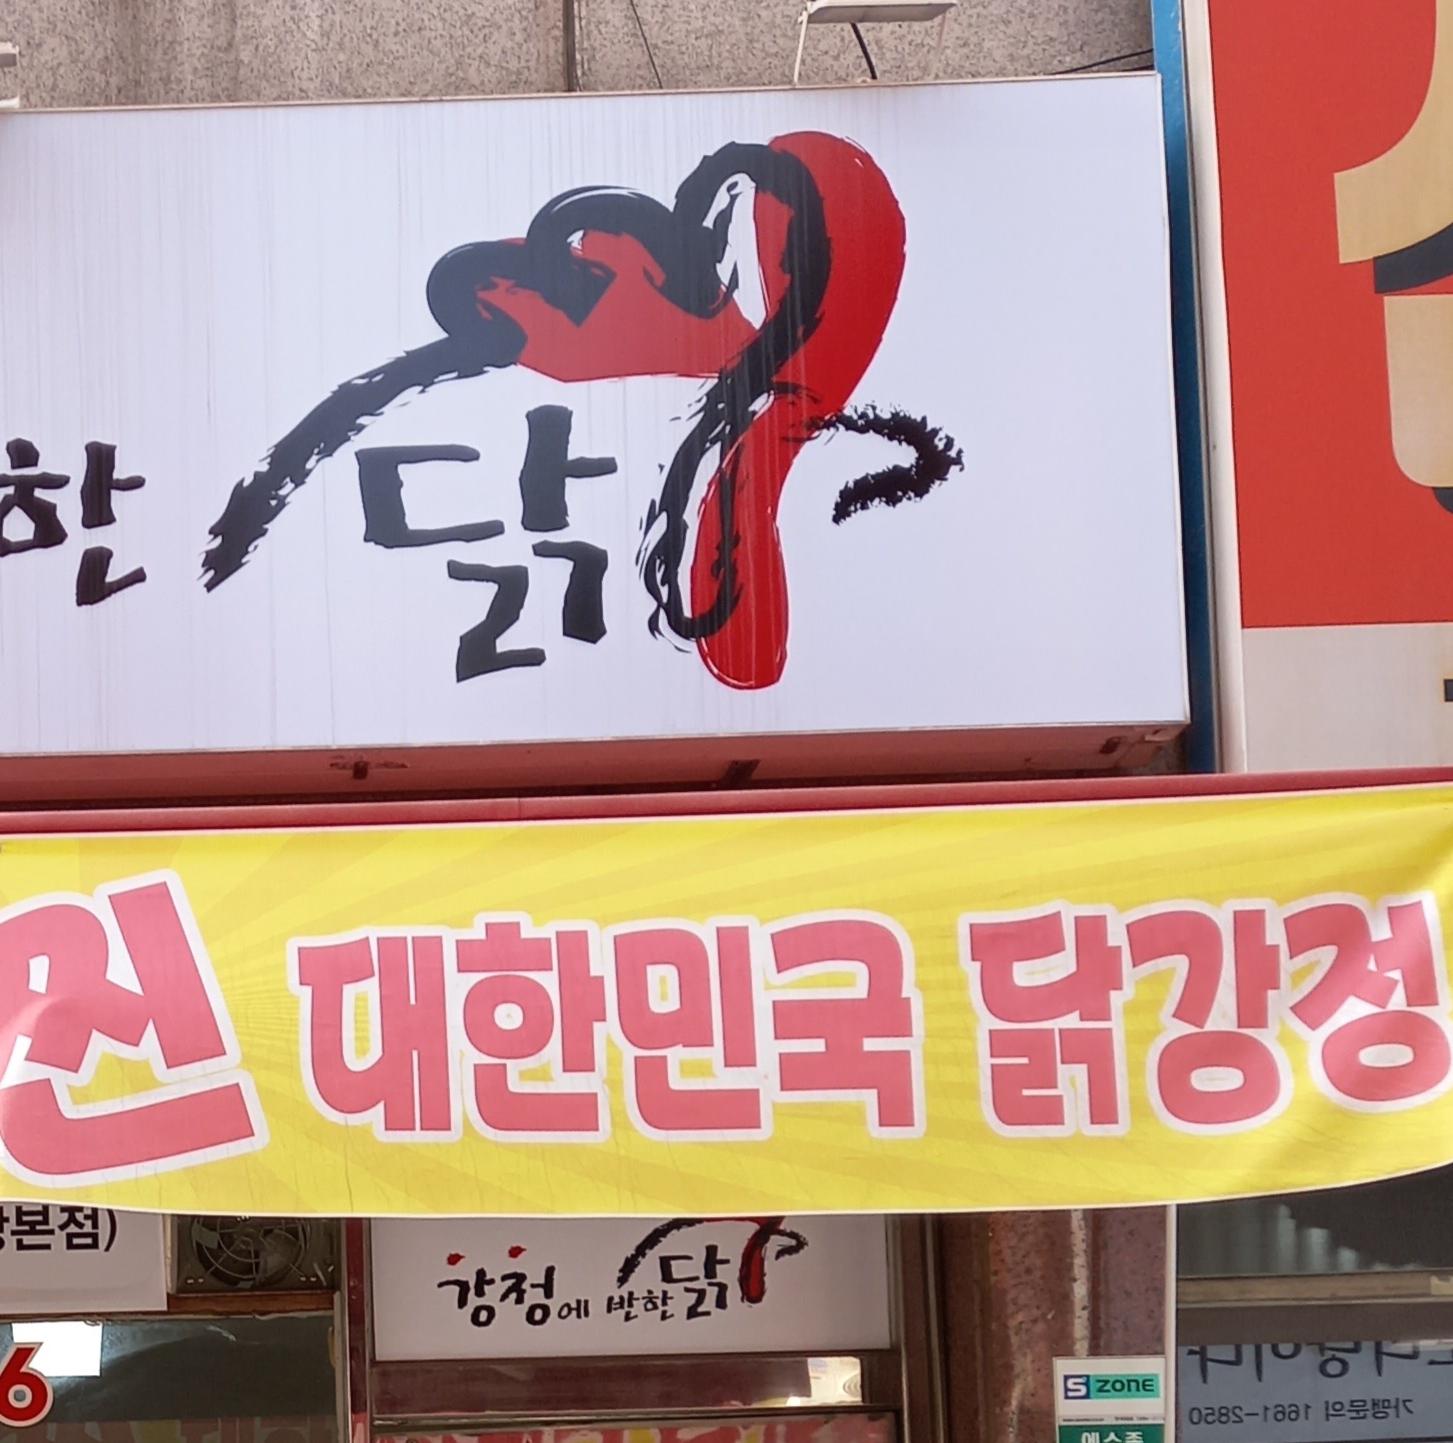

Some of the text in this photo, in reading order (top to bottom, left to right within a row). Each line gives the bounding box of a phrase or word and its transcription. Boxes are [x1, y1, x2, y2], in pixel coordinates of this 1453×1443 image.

[354, 405, 617, 682] 닭
[285, 910, 926, 1143] 대한민국
[958, 890, 1453, 1138] 닭강정
[606, 1291, 674, 1322] 반한
[658, 1244, 731, 1321] 닭
